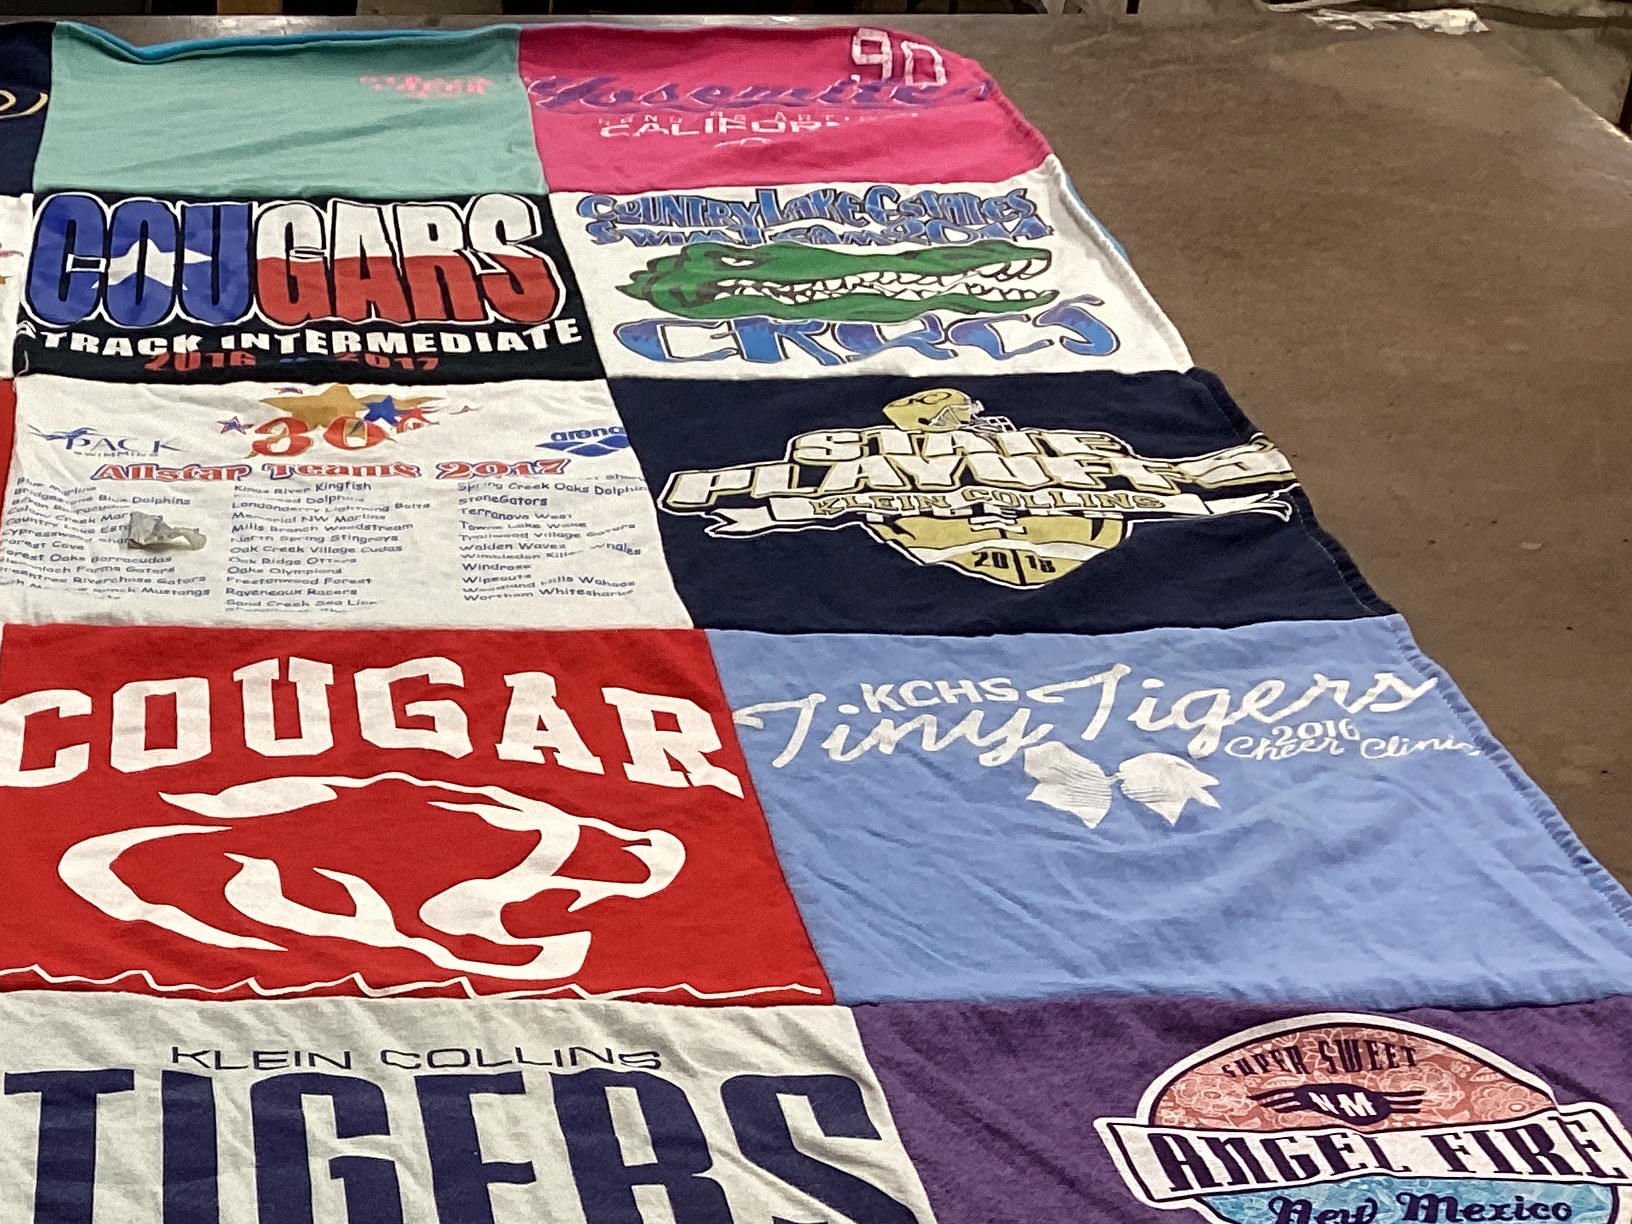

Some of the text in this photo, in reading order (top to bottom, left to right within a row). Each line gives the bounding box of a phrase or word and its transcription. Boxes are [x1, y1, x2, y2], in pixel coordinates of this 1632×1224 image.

[19, 192, 570, 328] COUGARS
[17, 319, 202, 358] TRACK
[220, 318, 583, 358] INTERMEDIATE
[792, 429, 1128, 465] STATE
[91, 463, 253, 481] Allstar
[262, 461, 423, 481] Teams
[435, 458, 572, 479] 2017
[315, 480, 372, 492] Kingfish
[507, 481, 550, 491] Creek
[554, 481, 590, 493] Oaks
[132, 495, 191, 506] Dolphins
[813, 489, 1166, 516] KLEIN COLLINS
[301, 514, 329, 523] NW
[460, 507, 530, 521] Terranova
[231, 521, 265, 533] Mills
[330, 533, 399, 545] Stingrays
[459, 542, 514, 552] Walden
[229, 544, 403, 556] Oak Creek Village Cudas
[90, 555, 172, 565] Barracudas
[261, 557, 302, 566] Ridge
[461, 562, 532, 572] Windrose
[972, 550, 1009, 570] 20
[227, 566, 264, 575] Oaks
[141, 586, 211, 598] Mustangs
[225, 586, 358, 598] Raveneaux Racers
[860, 677, 1020, 713] KCHS
[732, 663, 1438, 769] Tiny Tigers
[1271, 718, 1361, 747] 2016
[1224, 735, 1345, 761] Cheer
[171, 1045, 664, 1072] KLEIN COLLINS
[1220, 1038, 1420, 1080] SUPER SWEET
[1310, 1089, 1378, 1119] NM
[1147, 1110, 1630, 1193] ANGEL FIRE
[1398, 1190, 1574, 1224] Mexico
